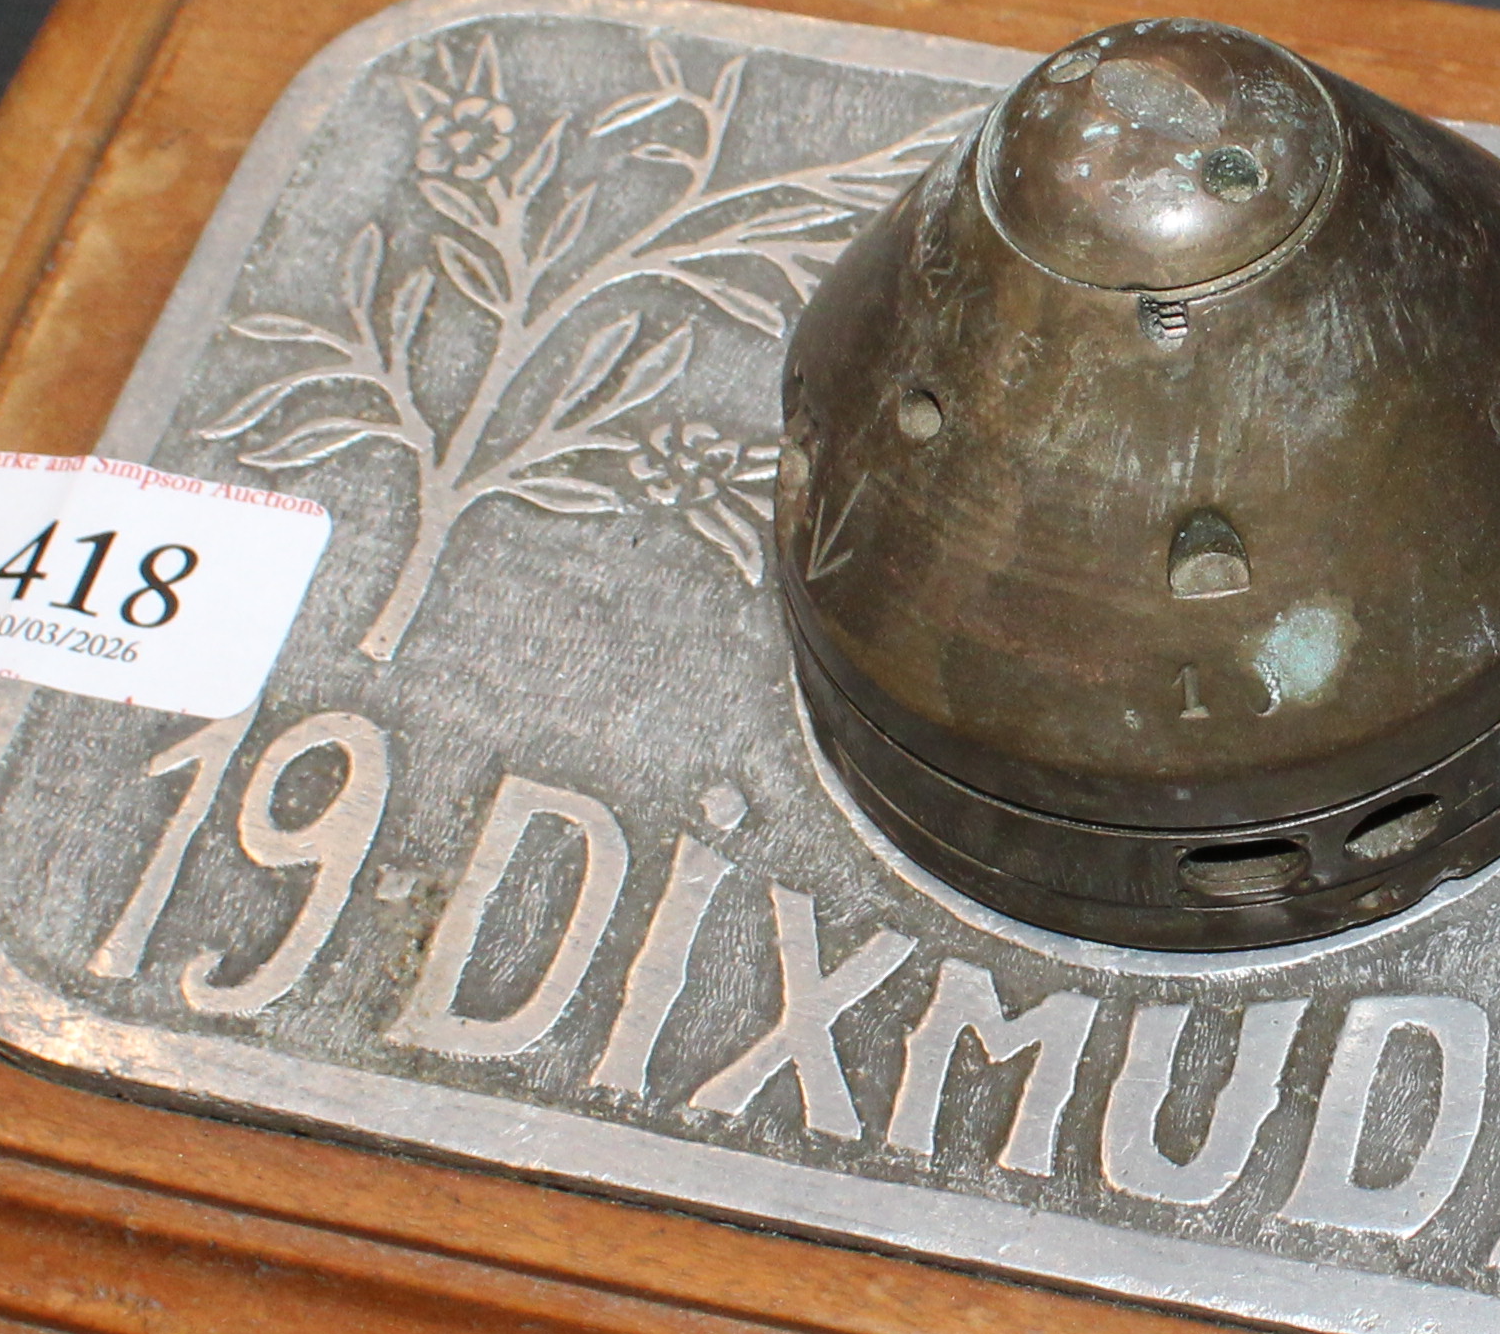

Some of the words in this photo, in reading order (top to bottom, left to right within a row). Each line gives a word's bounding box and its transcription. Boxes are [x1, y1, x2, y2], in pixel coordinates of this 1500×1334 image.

[45, 455, 86, 473] and
[93, 456, 203, 494] Simpson
[211, 482, 326, 518] Auctions
